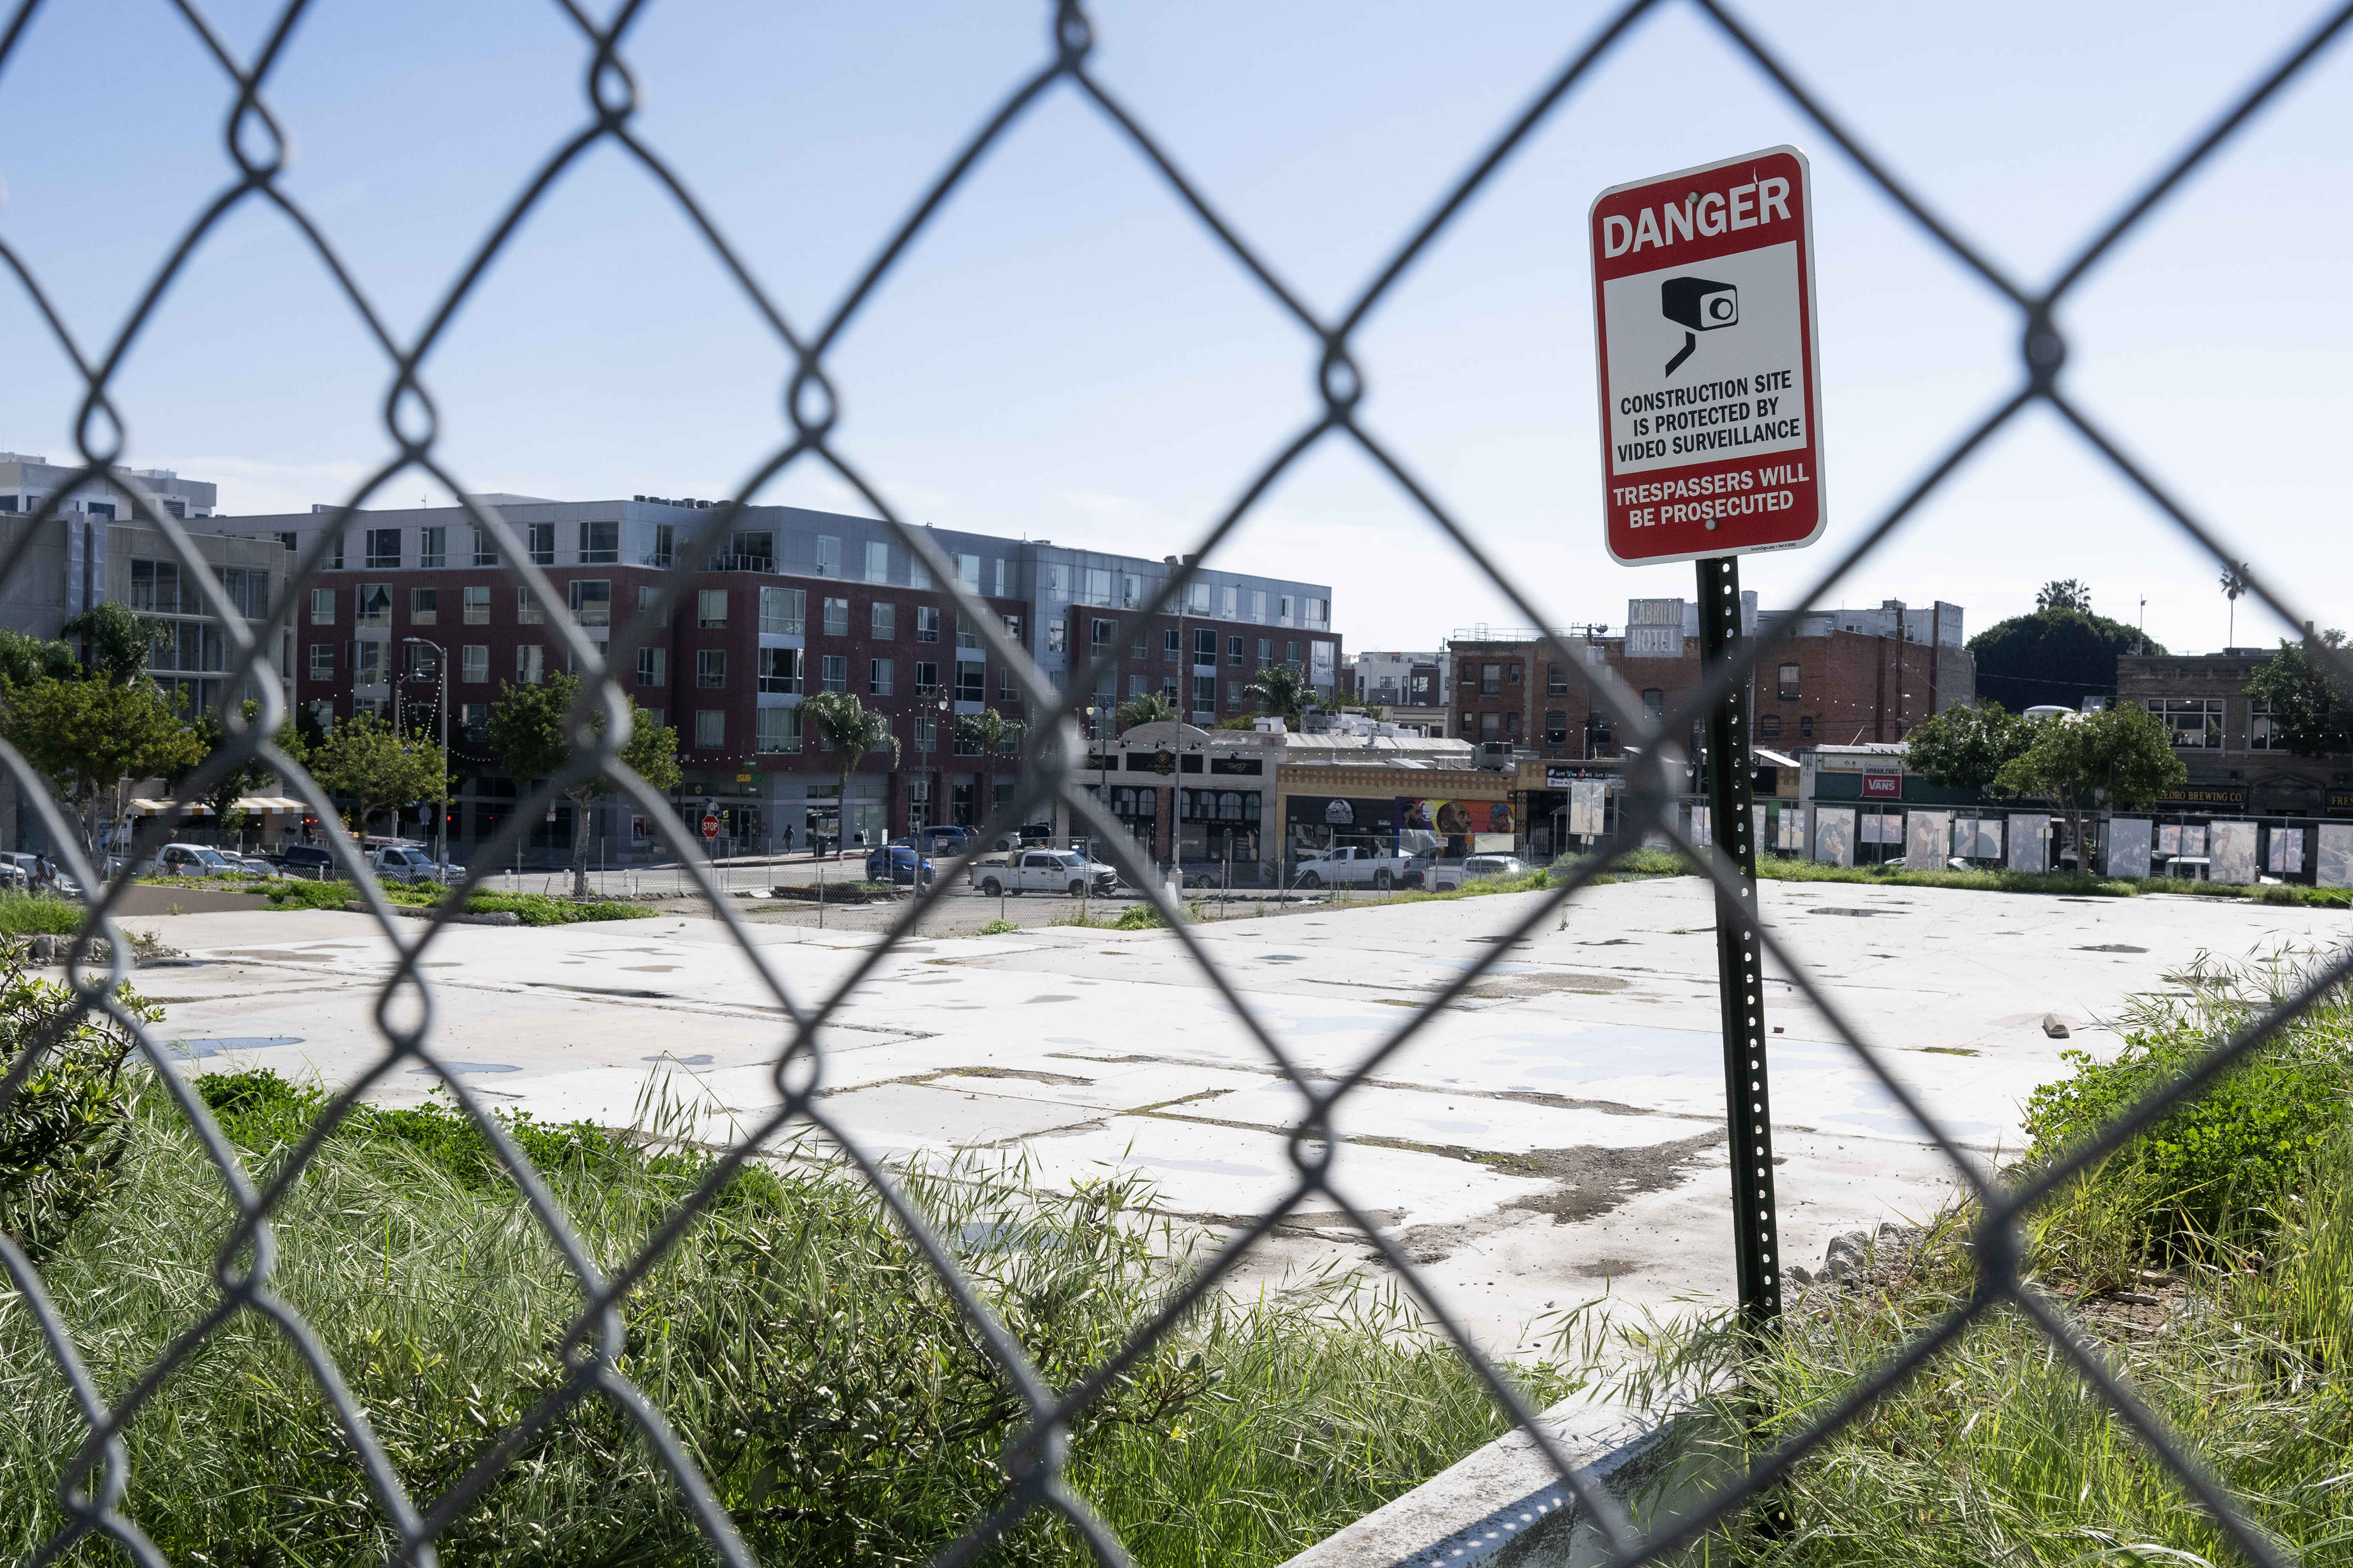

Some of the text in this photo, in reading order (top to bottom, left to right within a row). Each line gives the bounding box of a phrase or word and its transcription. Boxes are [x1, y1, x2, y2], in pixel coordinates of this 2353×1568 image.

[1603, 177, 1791, 258] DANGER
[1621, 370, 1792, 415] CONSTRUCTION SITE
[1634, 397, 1779, 437] IS PROTECTED BY
[1618, 418, 1801, 462] VIDEO SURVEILLANCE
[1613, 463, 1809, 506] TRESPASSERS WILL
[1629, 490, 1794, 529] BE PROSECUTED
[1631, 602, 1680, 624] CABRILLO
[1632, 629, 1676, 652] HOTEL
[1566, 770, 1577, 778] The
[1578, 768, 1592, 779] Wall
[1868, 779, 1895, 790] VANS
[2160, 791, 2186, 800] EDRO
[2188, 791, 2228, 801] BREWING
[703, 822, 718, 831] STOP
